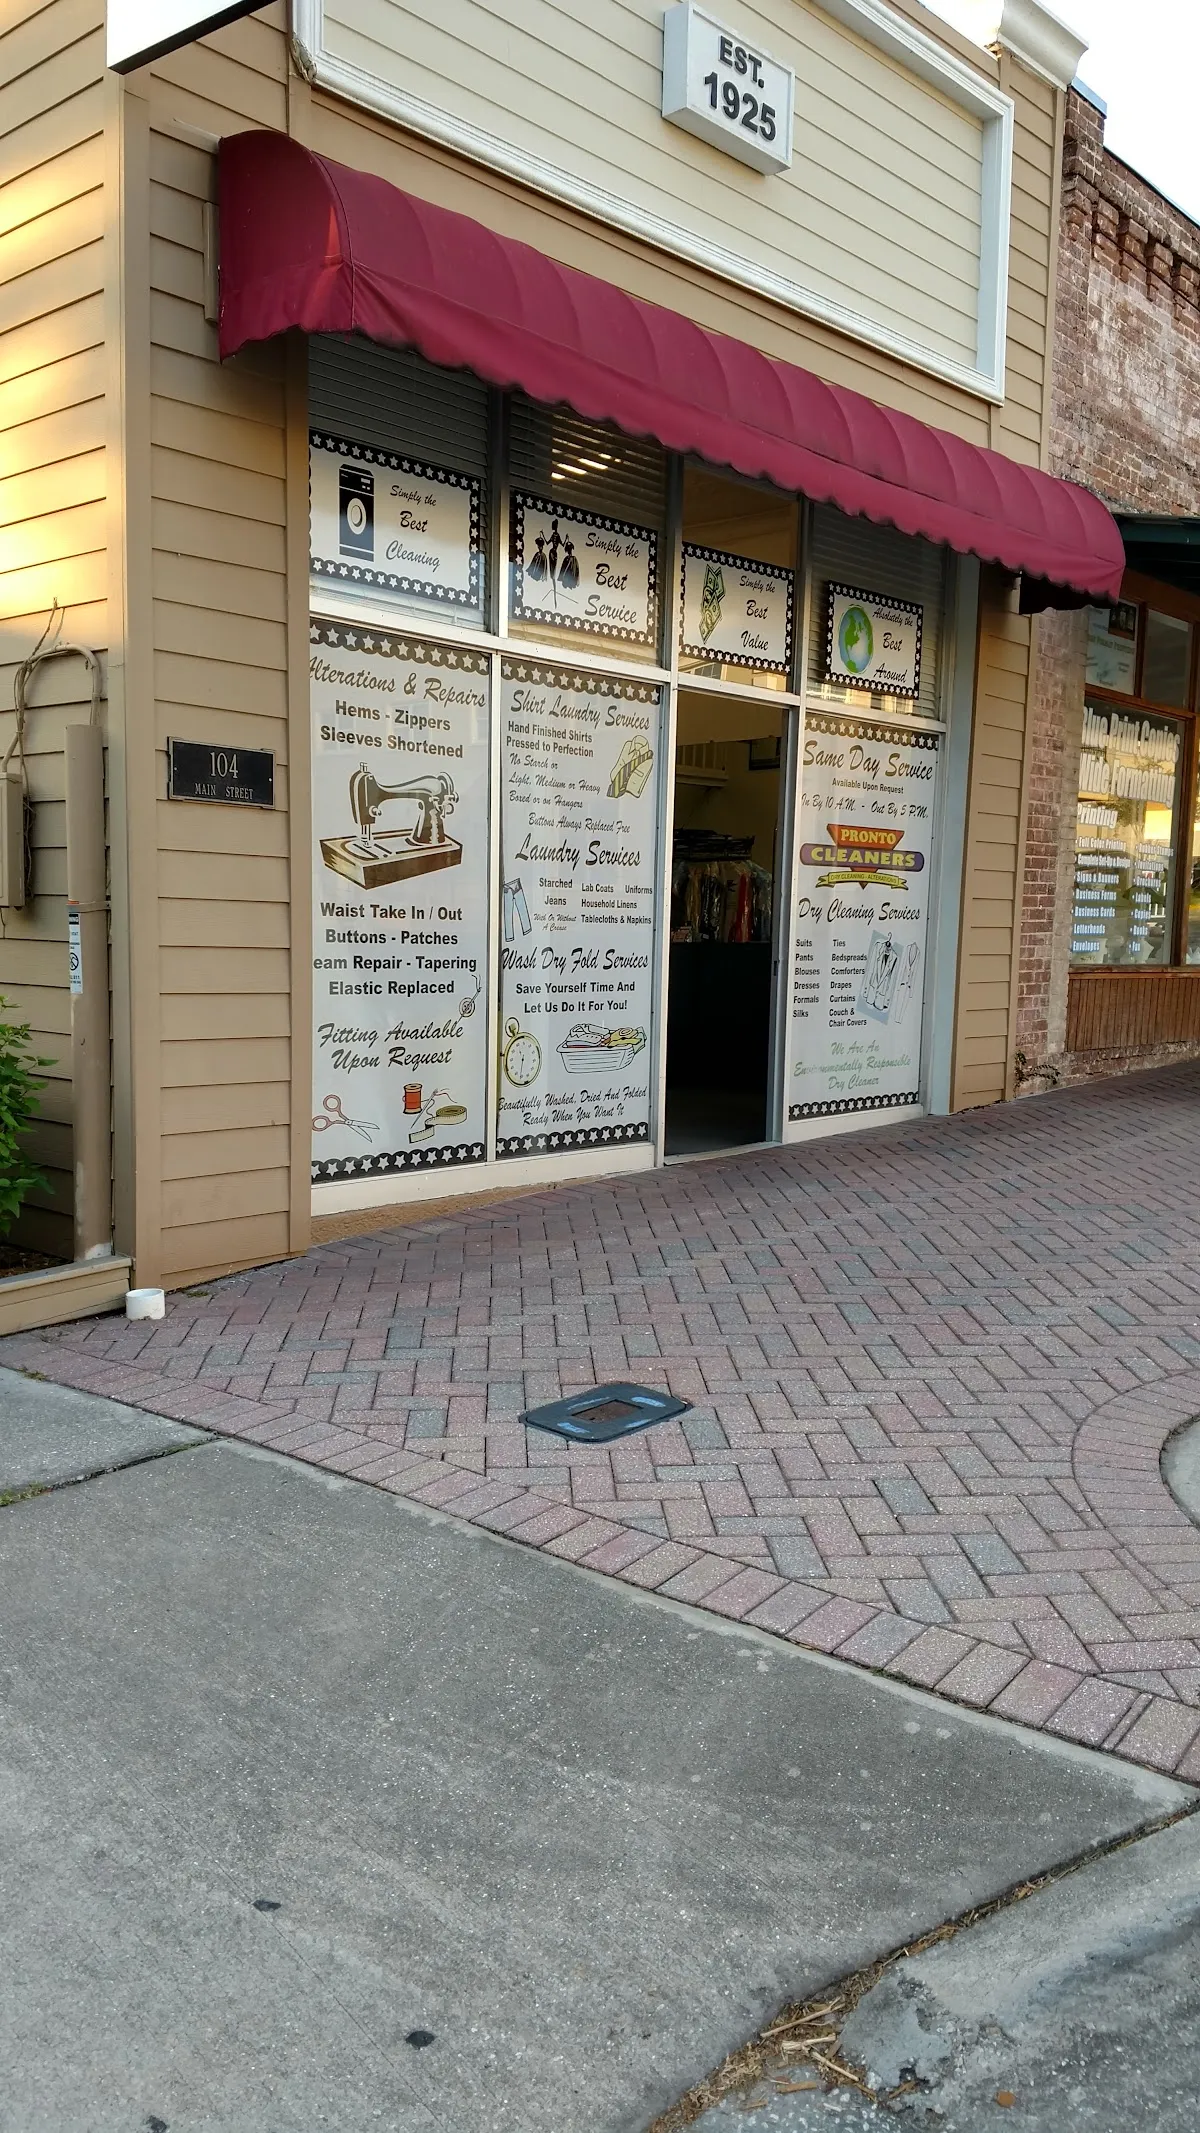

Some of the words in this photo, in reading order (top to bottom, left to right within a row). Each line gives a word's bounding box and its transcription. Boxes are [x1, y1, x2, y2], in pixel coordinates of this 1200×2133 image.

[719, 36, 765, 88] EST.
[704, 72, 776, 141] 1925
[390, 485, 422, 507] Simply
[424, 493, 437, 506] the
[400, 511, 428, 533] Best
[586, 532, 622, 558] Simply
[626, 543, 639, 559] the
[386, 540, 440, 573] Cleaning
[596, 563, 628, 591] Best
[740, 575, 764, 594] Simply
[766, 580, 775, 593] the
[585, 594, 637, 624] Service
[746, 600, 768, 619] Best
[873, 607, 903, 627] Absolutely
[905, 614, 914, 627] the
[741, 630, 769, 651] Value
[883, 632, 903, 652] Best
[873, 662, 906, 683] Around
[404, 672, 417, 695] &
[423, 677, 486, 708] Repairs
[336, 700, 380, 720] Hems
[395, 709, 451, 731] Zippers
[510, 690, 546, 715] Shirt
[549, 695, 600, 729] Laundry
[605, 705, 650, 730] Services
[508, 721, 530, 734] Hand
[532, 724, 566, 739] Finished
[569, 729, 593, 743] Shirts
[320, 725, 382, 748] Sleeves
[387, 735, 463, 758] Shortened
[506, 736, 540, 749] Pressed
[542, 741, 550, 751] to
[553, 742, 594, 758] Perfection
[1140, 720, 1180, 763] Copies
[209, 752, 239, 778] 104
[509, 753, 521, 766] No
[524, 755, 548, 769] Starch
[803, 740, 844, 768] Same
[849, 744, 881, 780] Day
[885, 752, 933, 781] Service
[195, 783, 216, 796] MAIN
[225, 786, 254, 799] STREET
[535, 774, 566, 789] Medium
[578, 780, 600, 795] Heavy
[832, 777, 861, 789] Available
[862, 781, 878, 792] Upon
[879, 784, 904, 794] Request
[1110, 759, 1176, 809] Formatting
[554, 795, 583, 810] Hangers
[812, 794, 822, 811] By
[825, 796, 834, 808] 10
[871, 800, 885, 814] Out
[887, 803, 898, 817] By
[528, 812, 555, 828] Buttons
[556, 815, 582, 831] Always
[584, 817, 614, 833] Replaced
[616, 820, 631, 834] Free
[840, 829, 897, 844] PRONTO
[515, 832, 580, 871] Laundry
[585, 840, 641, 866] Services
[811, 847, 916, 867] CLEANERS
[539, 877, 573, 889] Starched
[867, 874, 898, 883] ALTERATIONS
[581, 883, 594, 892] Lab
[595, 883, 614, 893] Coats
[625, 885, 653, 895] Uniforms
[1076, 888, 1100, 900] Business
[544, 895, 567, 906] Jeans
[581, 899, 615, 909] Household
[617, 900, 637, 909] Linens
[320, 902, 365, 918] Waist
[370, 904, 407, 919] Take
[411, 905, 425, 920] In
[429, 906, 434, 920] /
[437, 906, 463, 921] Out
[581, 914, 618, 924] Tablecloths
[626, 915, 652, 926] Napkins
[799, 897, 822, 924] Dry
[827, 898, 875, 925] Cleaning
[878, 902, 921, 921] Services
[1075, 906, 1099, 917] Business
[325, 929, 387, 944] Buttons
[401, 931, 458, 945] Patches
[1073, 923, 1106, 934] Letterheads
[796, 939, 813, 947] Suits
[833, 939, 846, 947] Ties
[1072, 941, 1100, 952] Envelopes
[313, 957, 348, 969] eam
[353, 956, 403, 972] Repair
[416, 956, 477, 972] Tapering
[502, 947, 537, 970] Wash
[541, 947, 567, 976] Dry
[571, 947, 600, 974] Fold
[603, 948, 649, 970] Services
[795, 953, 814, 962] Pants
[831, 953, 867, 963] Bedspreads
[794, 967, 820, 976] Blouses
[830, 967, 865, 975] Comforters
[329, 981, 383, 995] Elastic
[388, 980, 455, 997] Replaced
[515, 983, 541, 994] Save
[545, 982, 587, 994] Yourself
[590, 981, 614, 993] Time
[617, 981, 635, 992] And
[794, 981, 820, 990] Dresses
[830, 981, 852, 991] Drapes
[524, 1002, 541, 1013] Let
[545, 1001, 558, 1013] Us
[561, 1001, 575, 1012] Do
[578, 1001, 585, 1011] It
[588, 1001, 604, 1011] For
[607, 1000, 628, 1010] You!
[793, 995, 820, 1004] Formals
[829, 994, 856, 1003] Curtains
[792, 1009, 809, 1018] Silks
[829, 1008, 848, 1017] Couch
[828, 1018, 845, 1028] Chair
[846, 1018, 867, 1027] Covers
[317, 1023, 379, 1048] Fitting
[384, 1019, 464, 1043] Available
[847, 1041, 863, 1055] Are
[866, 1040, 880, 1053] An
[331, 1048, 381, 1074] Upon
[388, 1046, 452, 1072] Request
[866, 1054, 911, 1071] Responsible
[828, 1075, 845, 1092] Dry
[848, 1074, 879, 1090] Cleaner
[499, 1097, 541, 1113] Beautifully
[580, 1089, 601, 1103] Dried
[603, 1087, 620, 1101] And
[623, 1086, 647, 1100] Folded
[522, 1112, 549, 1127] Ready
[552, 1109, 573, 1123] When
[576, 1107, 591, 1120] You
[594, 1104, 614, 1118] Want
